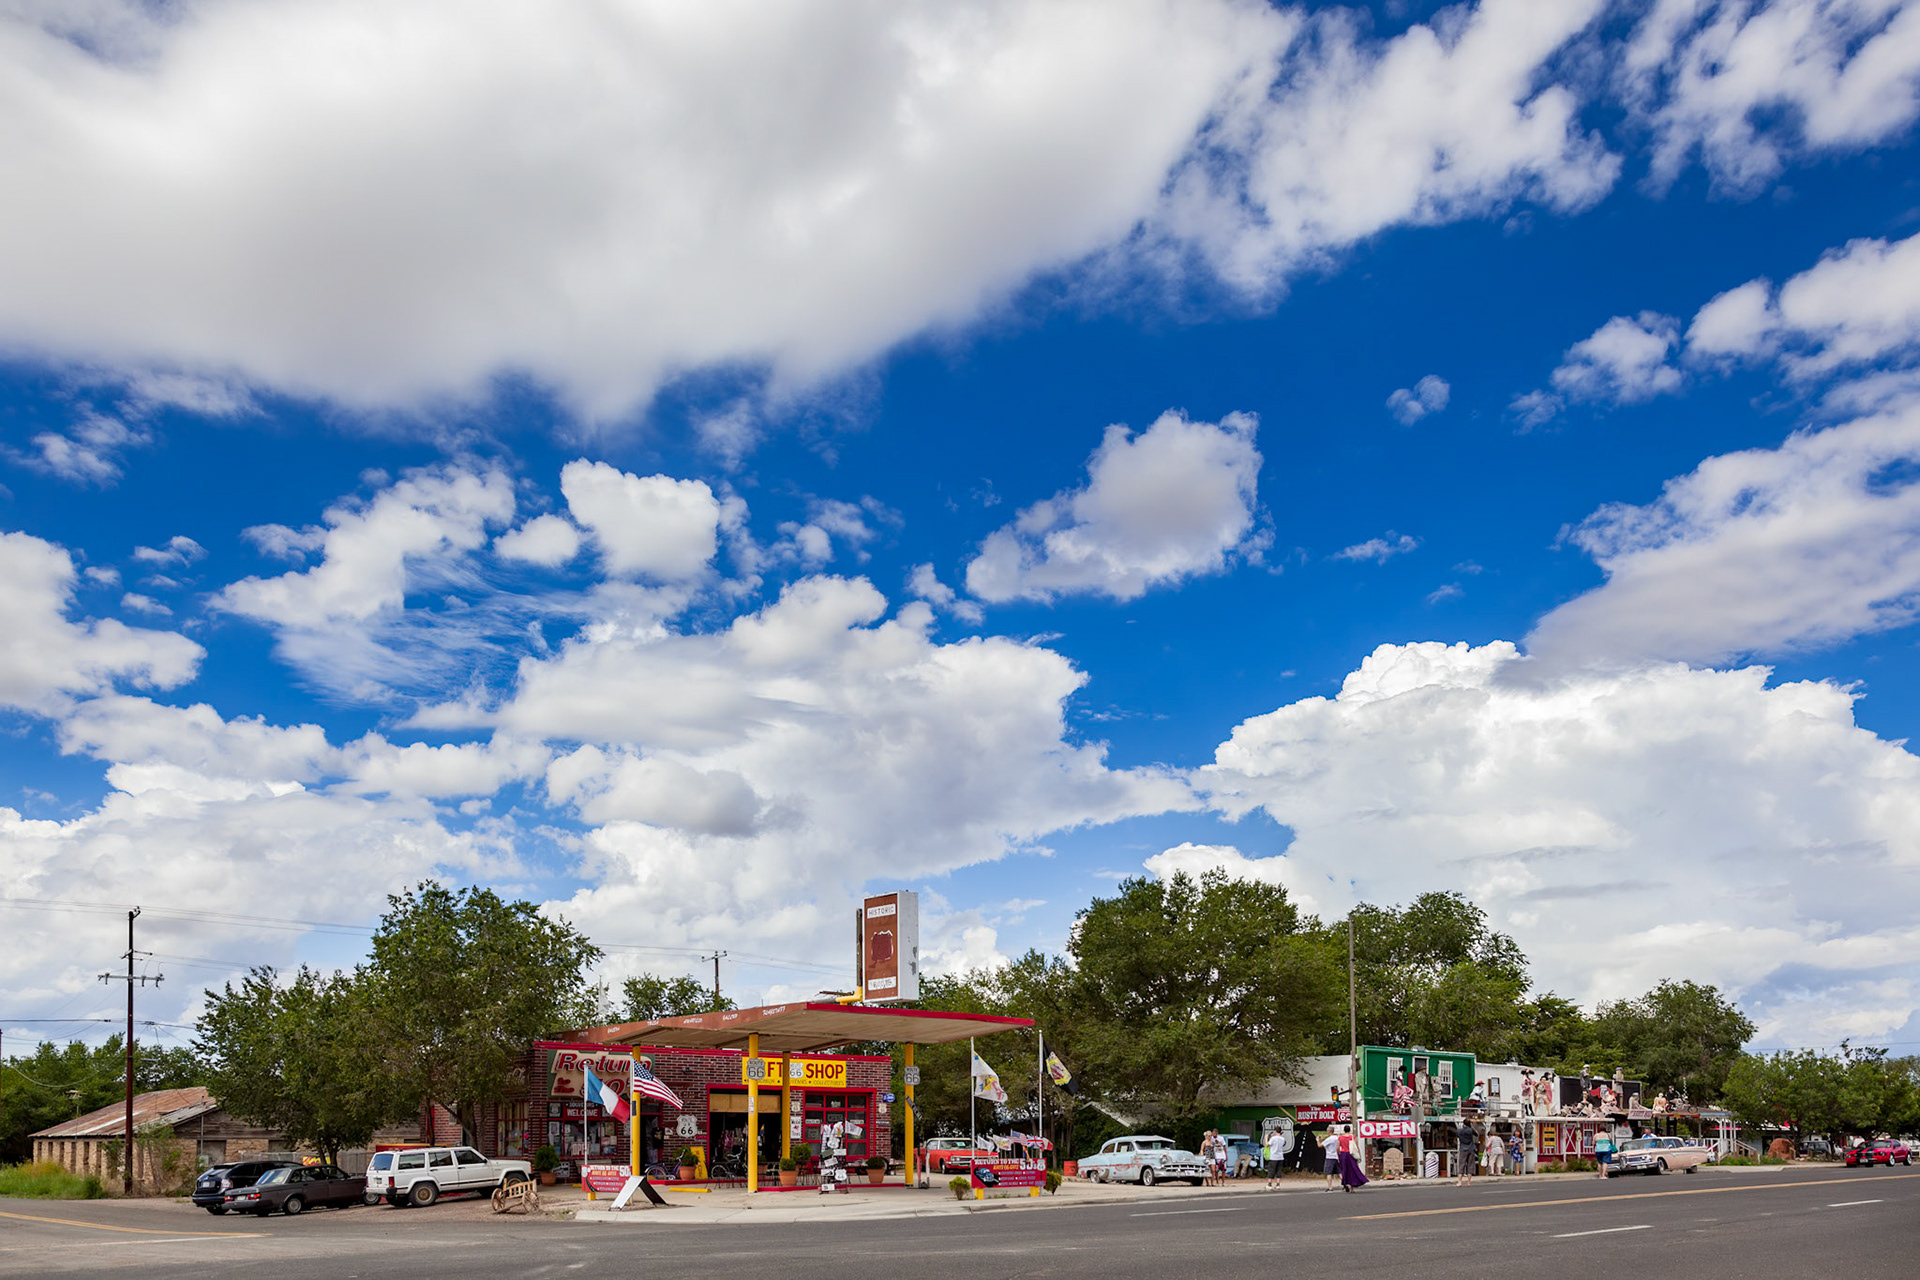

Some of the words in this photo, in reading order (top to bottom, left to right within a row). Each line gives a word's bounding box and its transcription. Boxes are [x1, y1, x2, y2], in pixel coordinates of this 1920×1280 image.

[868, 906, 894, 916] HISTORIC
[748, 1066, 765, 1078] 66
[790, 1069, 802, 1077] 66
[805, 1063, 844, 1079] SHOP
[905, 1072, 920, 1083] 66
[1297, 1111, 1318, 1120] RUSTY
[1318, 1111, 1336, 1120] BOLT
[681, 1126, 693, 1135] 66
[1360, 1122, 1416, 1136] OPEN
